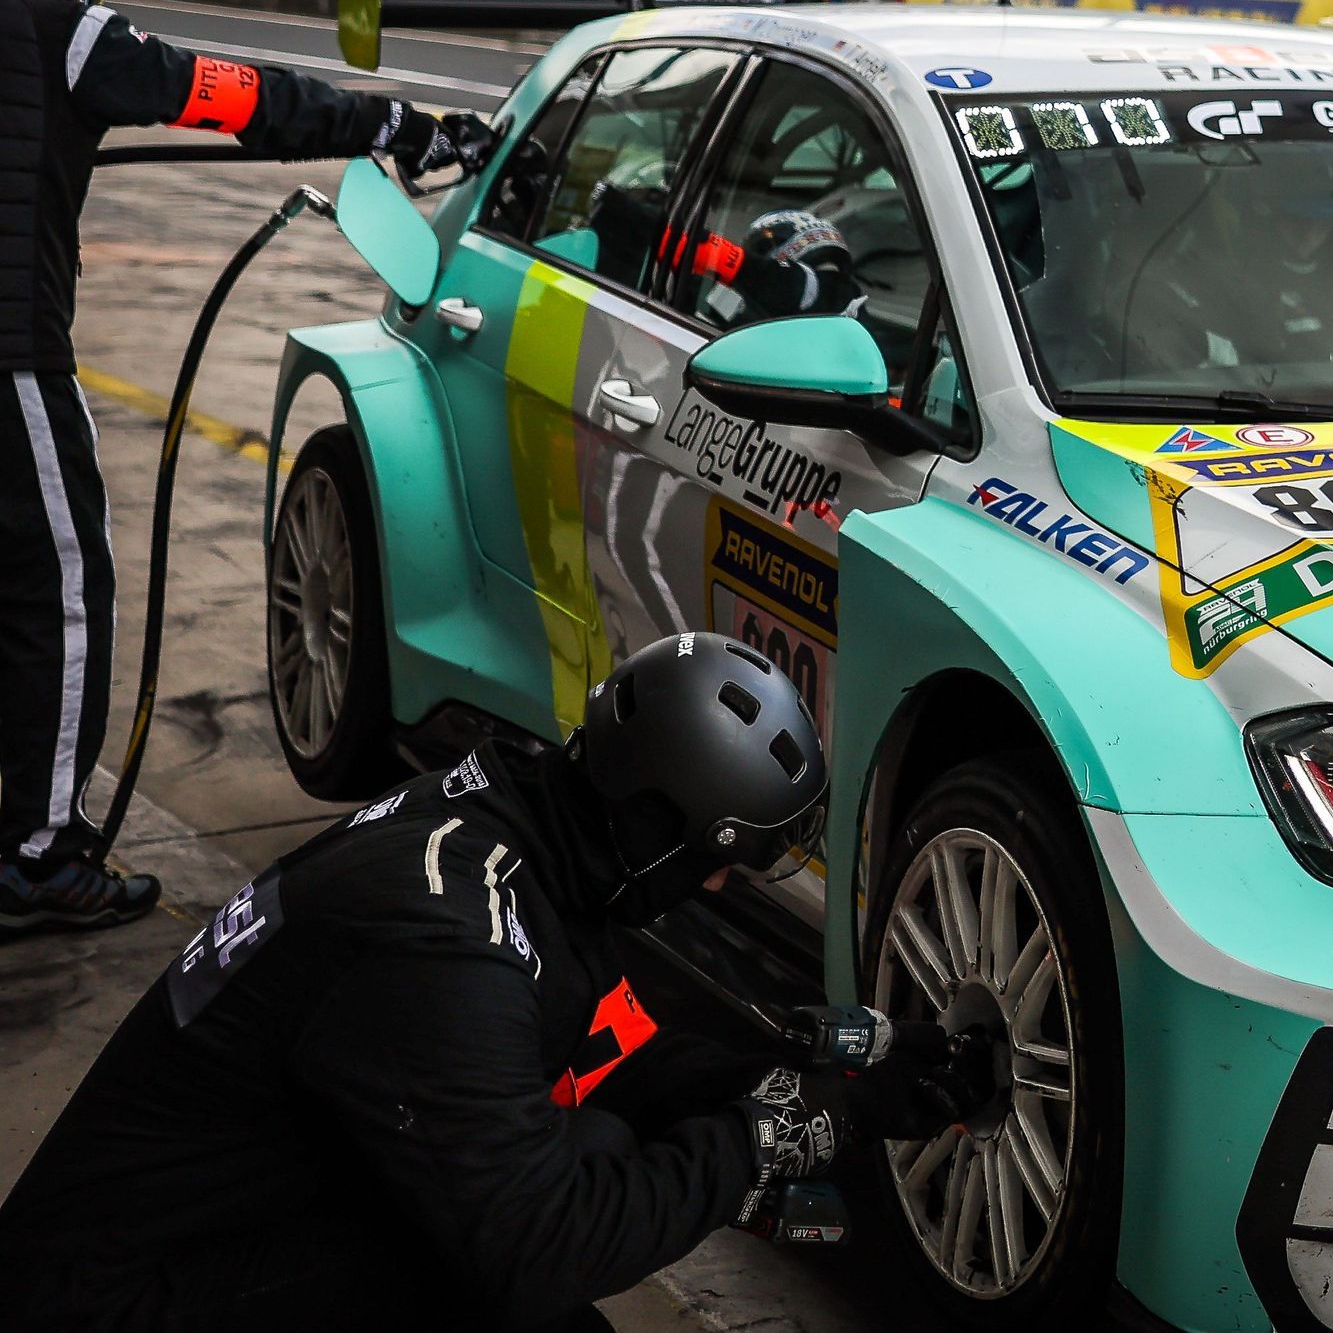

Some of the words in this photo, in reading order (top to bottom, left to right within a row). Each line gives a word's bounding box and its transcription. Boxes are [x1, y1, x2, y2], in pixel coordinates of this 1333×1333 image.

[664, 386, 842, 525] LangeGruppe
[725, 529, 829, 614] RAVENOL
[972, 476, 1149, 586] FALKEN
[791, 1228, 809, 1238] 18V
